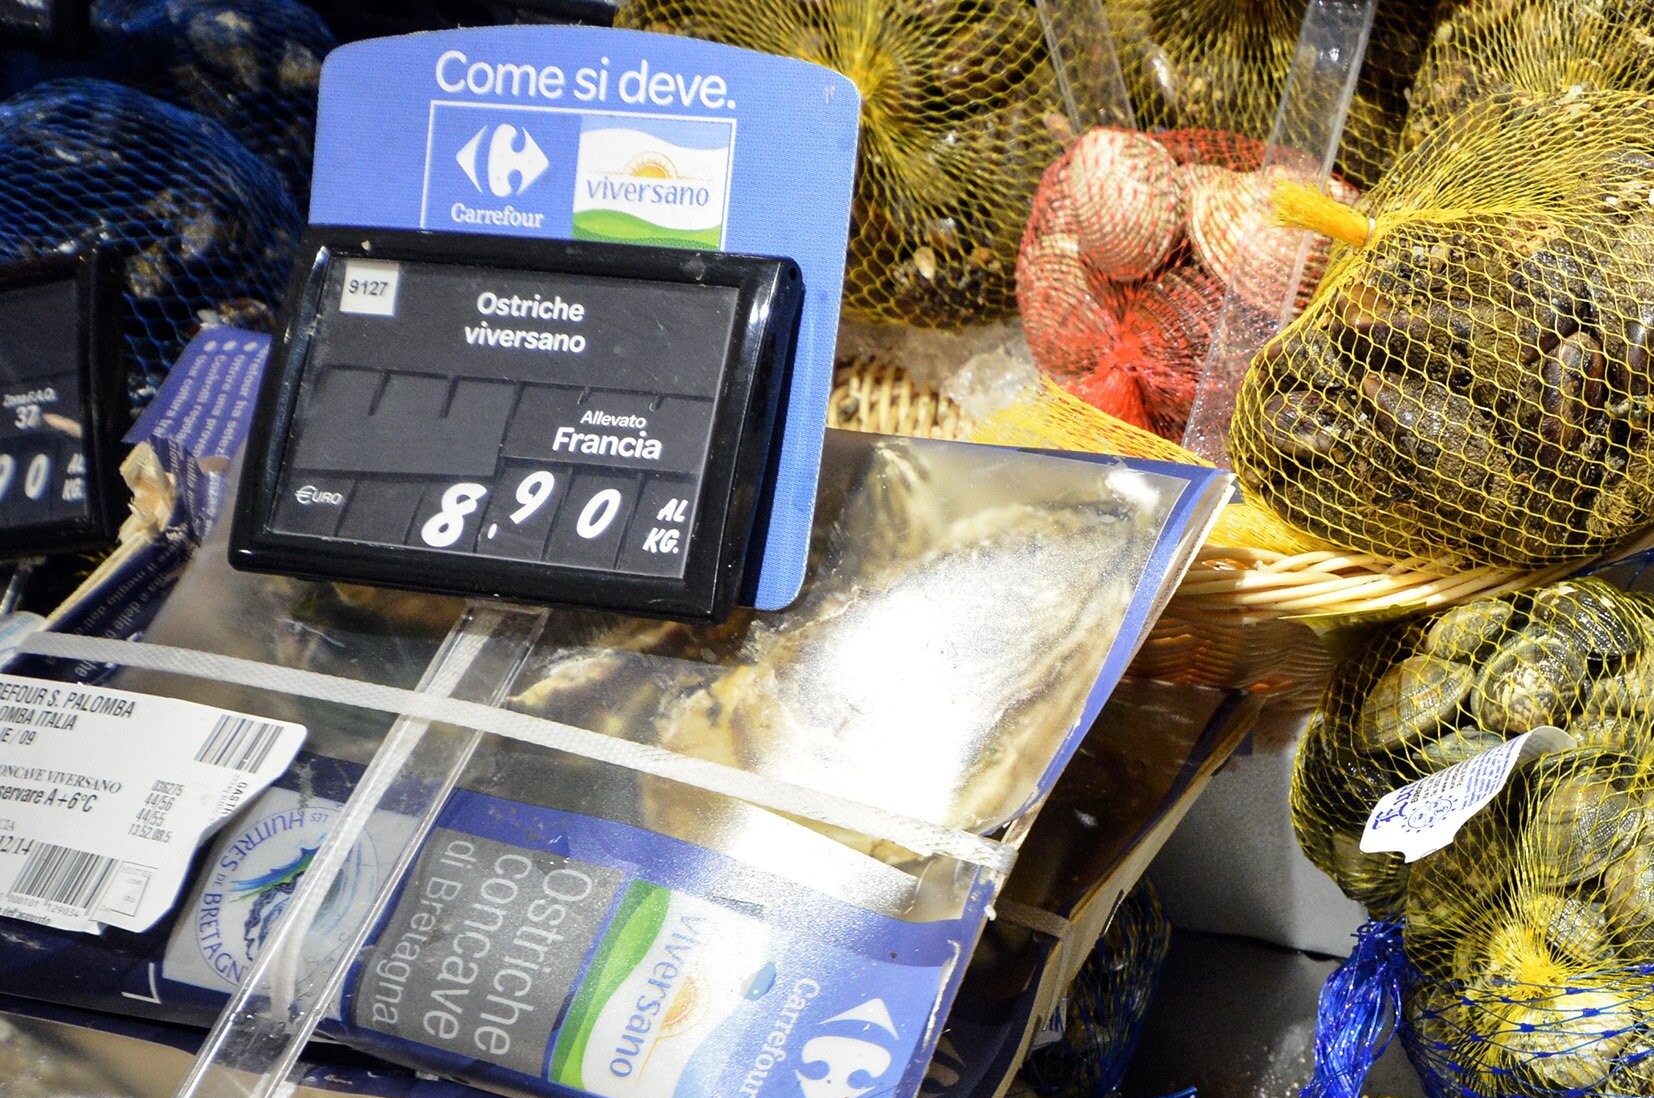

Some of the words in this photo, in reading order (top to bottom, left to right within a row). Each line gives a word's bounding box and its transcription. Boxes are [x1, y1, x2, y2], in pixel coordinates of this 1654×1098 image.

[434, 50, 565, 98] Come
[573, 55, 610, 100] si
[618, 61, 738, 110] deve.
[585, 174, 710, 208] viversano
[449, 203, 546, 230] Carrefour
[348, 278, 390, 299] 9127
[477, 291, 586, 323] Ostriche
[463, 322, 587, 354] viversano
[579, 409, 647, 430] Allevato
[551, 427, 664, 462] Francia
[655, 497, 686, 523] AL
[642, 526, 680, 555] KG.
[112, 598, 142, 632] delle
[45, 688, 60, 708] S.
[61, 690, 135, 718] PALOMBA
[33, 709, 77, 730] ITALIA
[17, 729, 37, 745] 09
[45, 769, 122, 793] VIVERSANO
[439, 839, 478, 870] di
[199, 892, 248, 983] BRETAGN
[371, 876, 463, 1026] Bretagna
[473, 868, 593, 1056] Ostriche
[608, 914, 707, 1079] viversano
